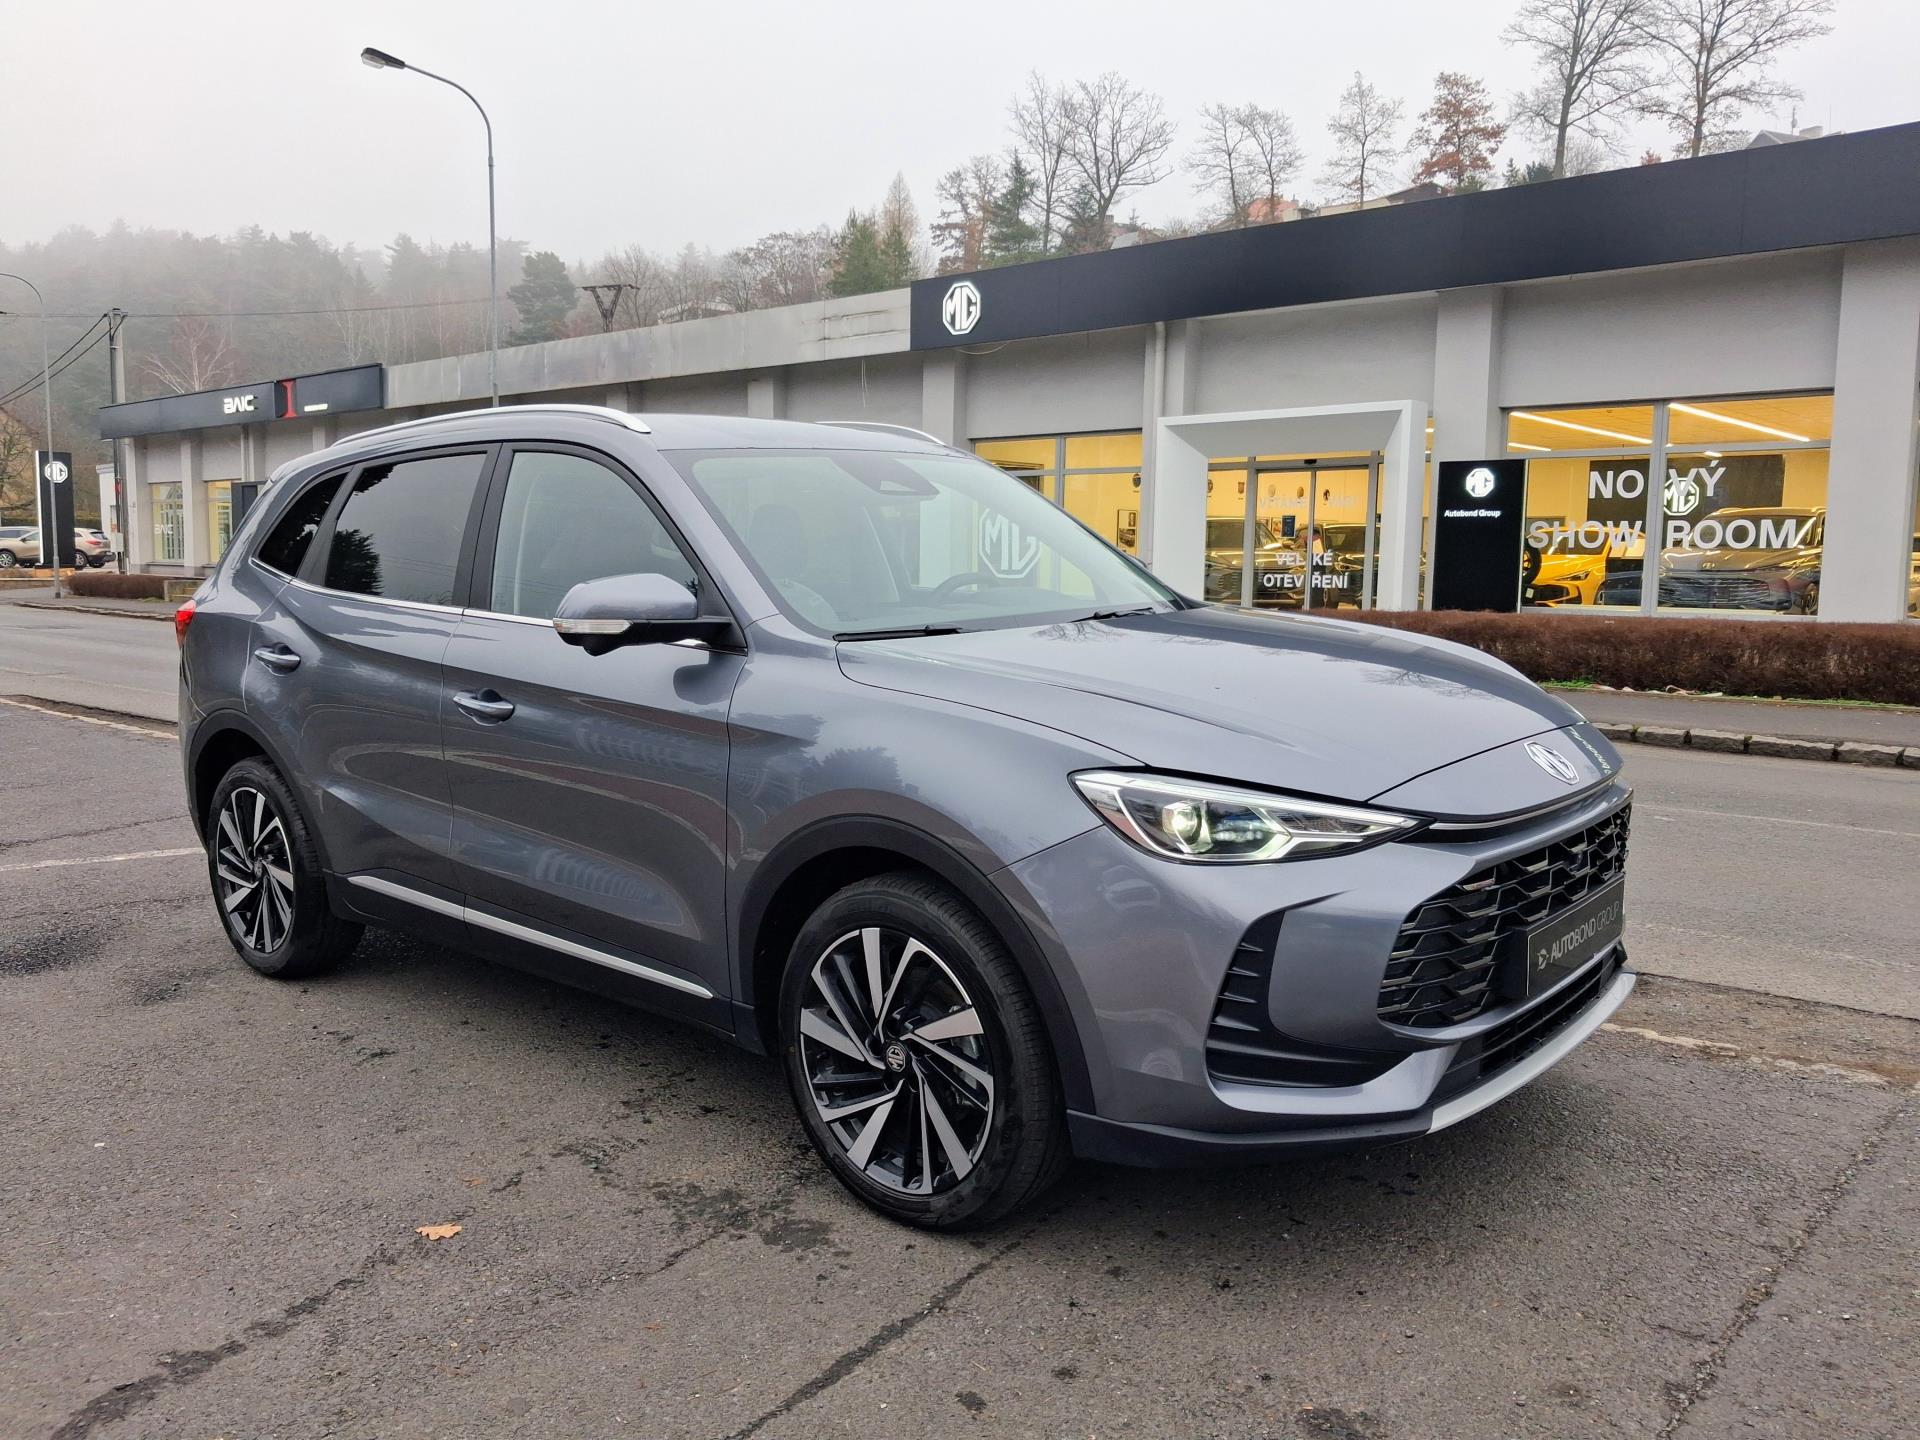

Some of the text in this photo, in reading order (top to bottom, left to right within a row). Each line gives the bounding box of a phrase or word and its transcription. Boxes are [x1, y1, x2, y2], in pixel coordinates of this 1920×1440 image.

[945, 285, 978, 332] MG
[1466, 470, 1494, 496] MG
[1444, 509, 1502, 519] Autobond Group
[1527, 518, 1797, 549] SHOW ROOM
[1550, 901, 1620, 963] AUTOBOND GROUP
